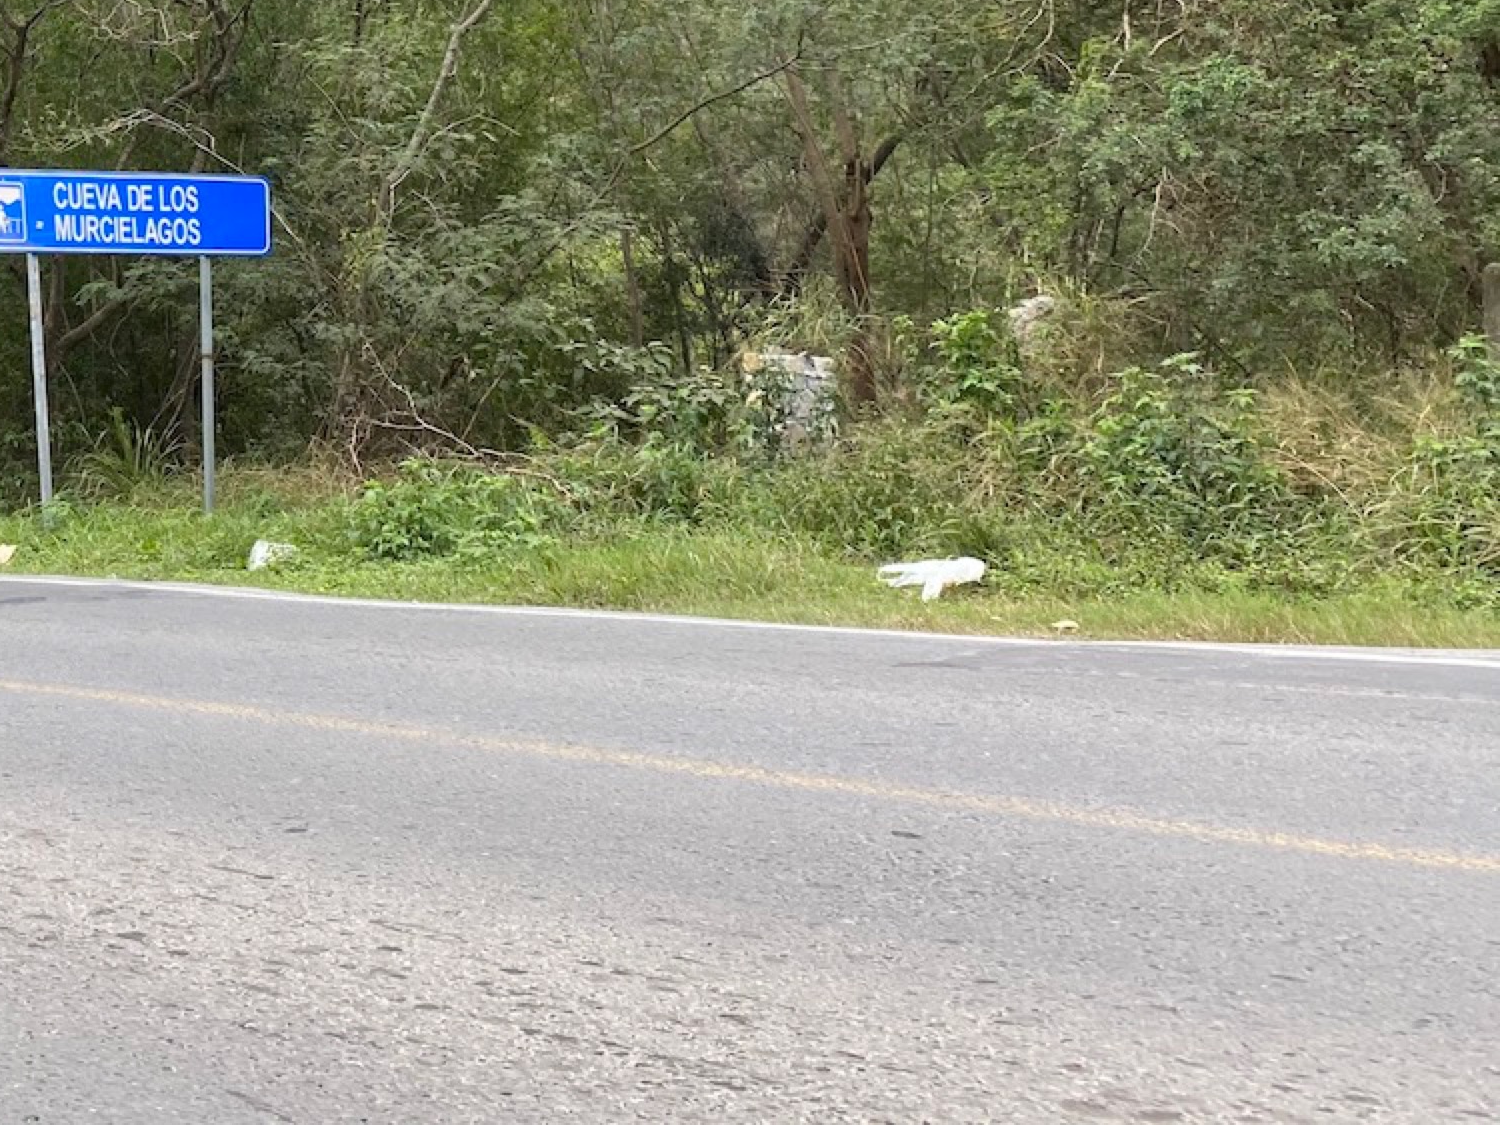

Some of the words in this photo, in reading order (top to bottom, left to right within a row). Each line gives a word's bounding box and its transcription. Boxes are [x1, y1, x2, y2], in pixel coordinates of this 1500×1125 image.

[53, 181, 122, 210] CUEVA
[127, 185, 154, 212] DE
[159, 185, 199, 213] LOS
[54, 214, 202, 246] MURCIELAGOS
